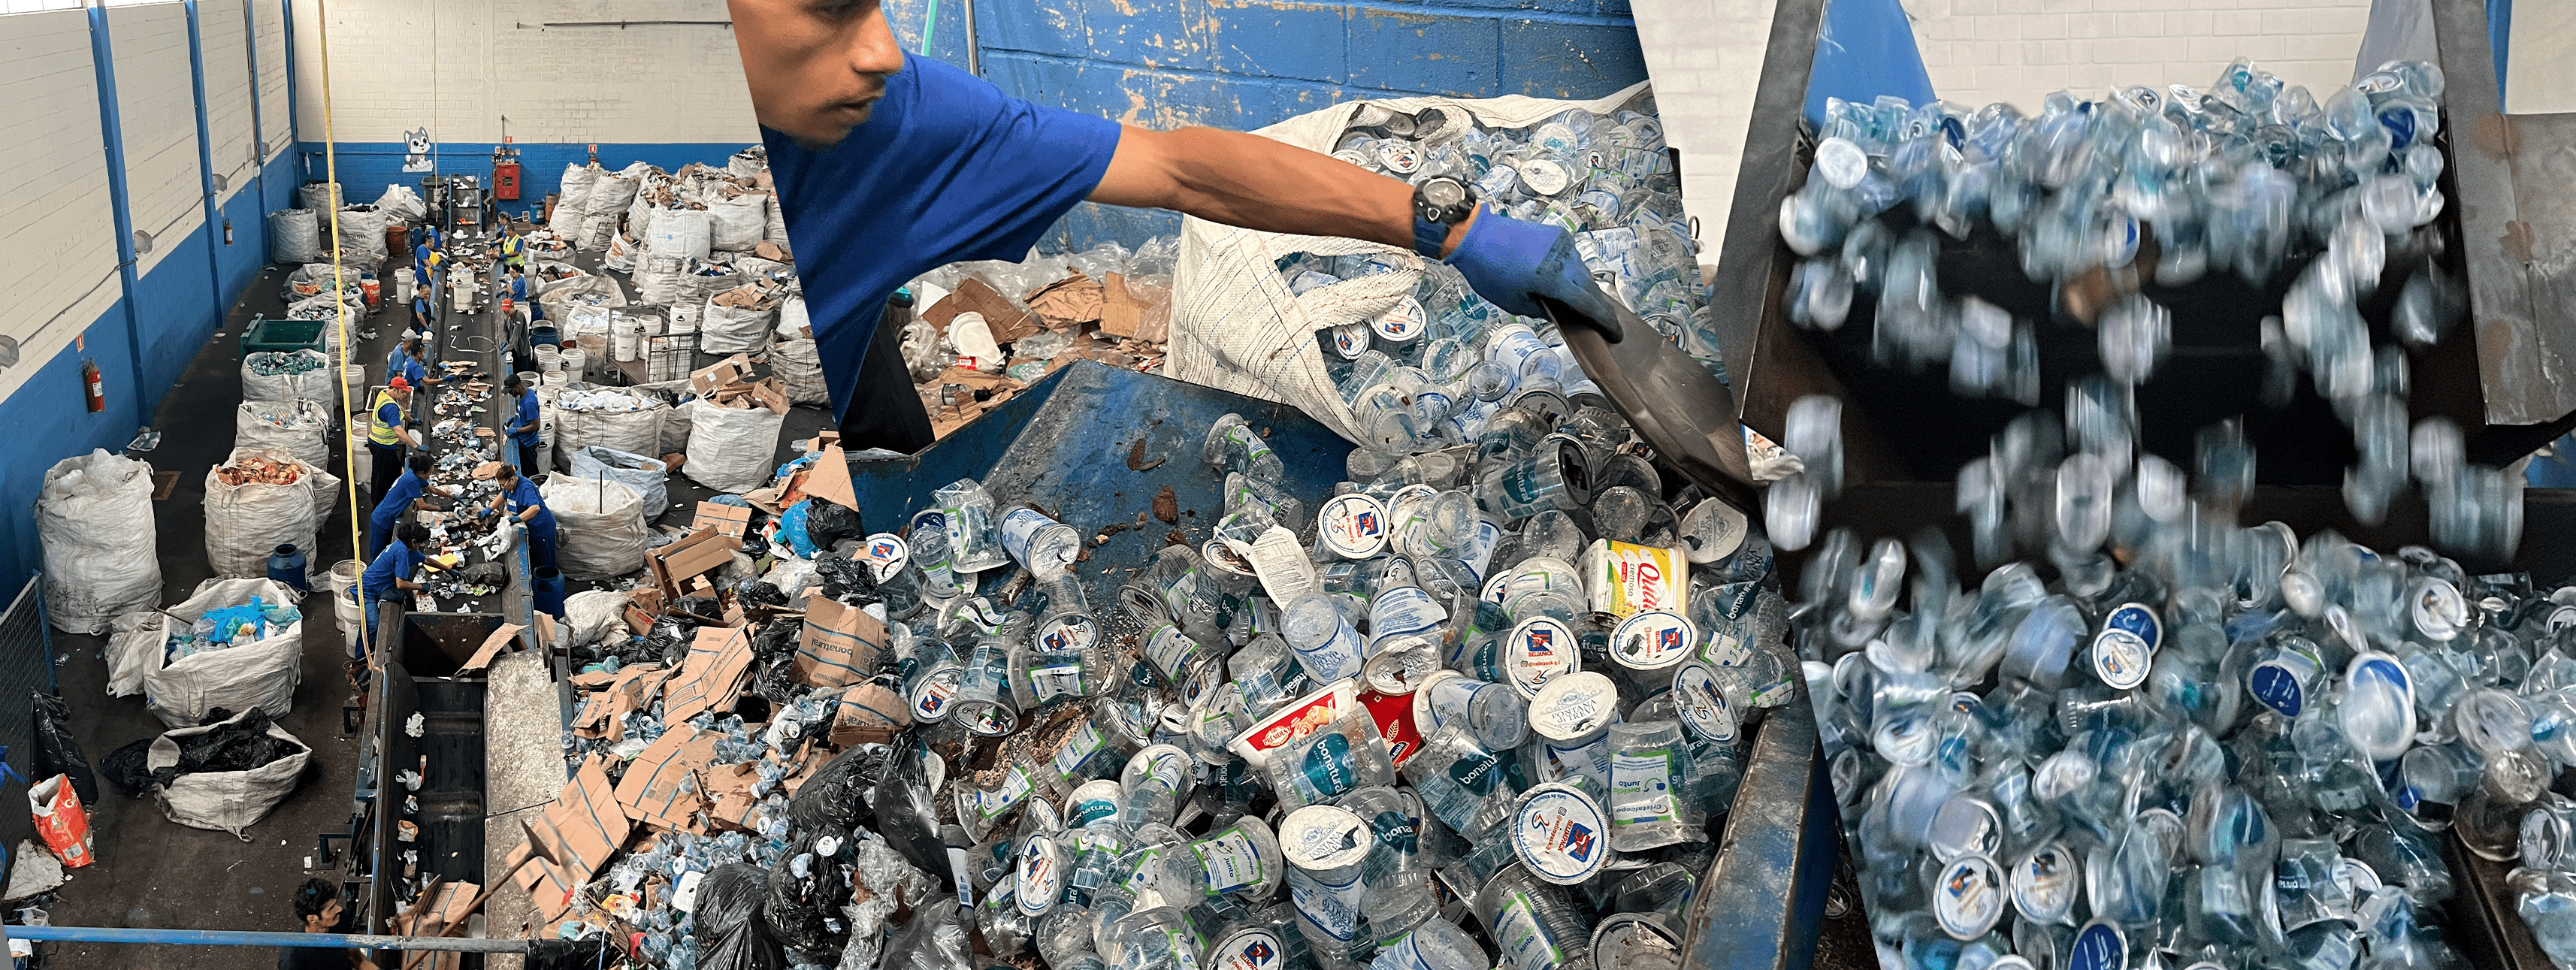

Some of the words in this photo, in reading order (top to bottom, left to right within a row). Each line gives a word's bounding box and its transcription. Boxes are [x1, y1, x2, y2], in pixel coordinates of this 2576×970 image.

[812, 637, 854, 657] bonatural
[1552, 699, 1598, 719] FONTANA
[1557, 715, 1566, 724] di
[1568, 704, 1597, 721] TREVI
[1069, 743, 1078, 757] Junto
[1317, 739, 1347, 793] bonatural
[1068, 803, 1114, 826] bonatural
[1616, 804, 1661, 813] Cristalcopo
[1381, 825, 1413, 842] bona
[1558, 819, 1574, 853] SELIMPACK
[1235, 839, 1254, 875] Cristalcopo
[1223, 857, 1234, 878] Junto
[1229, 855, 1241, 882] Recicla
[1519, 935, 1534, 954] Junto
